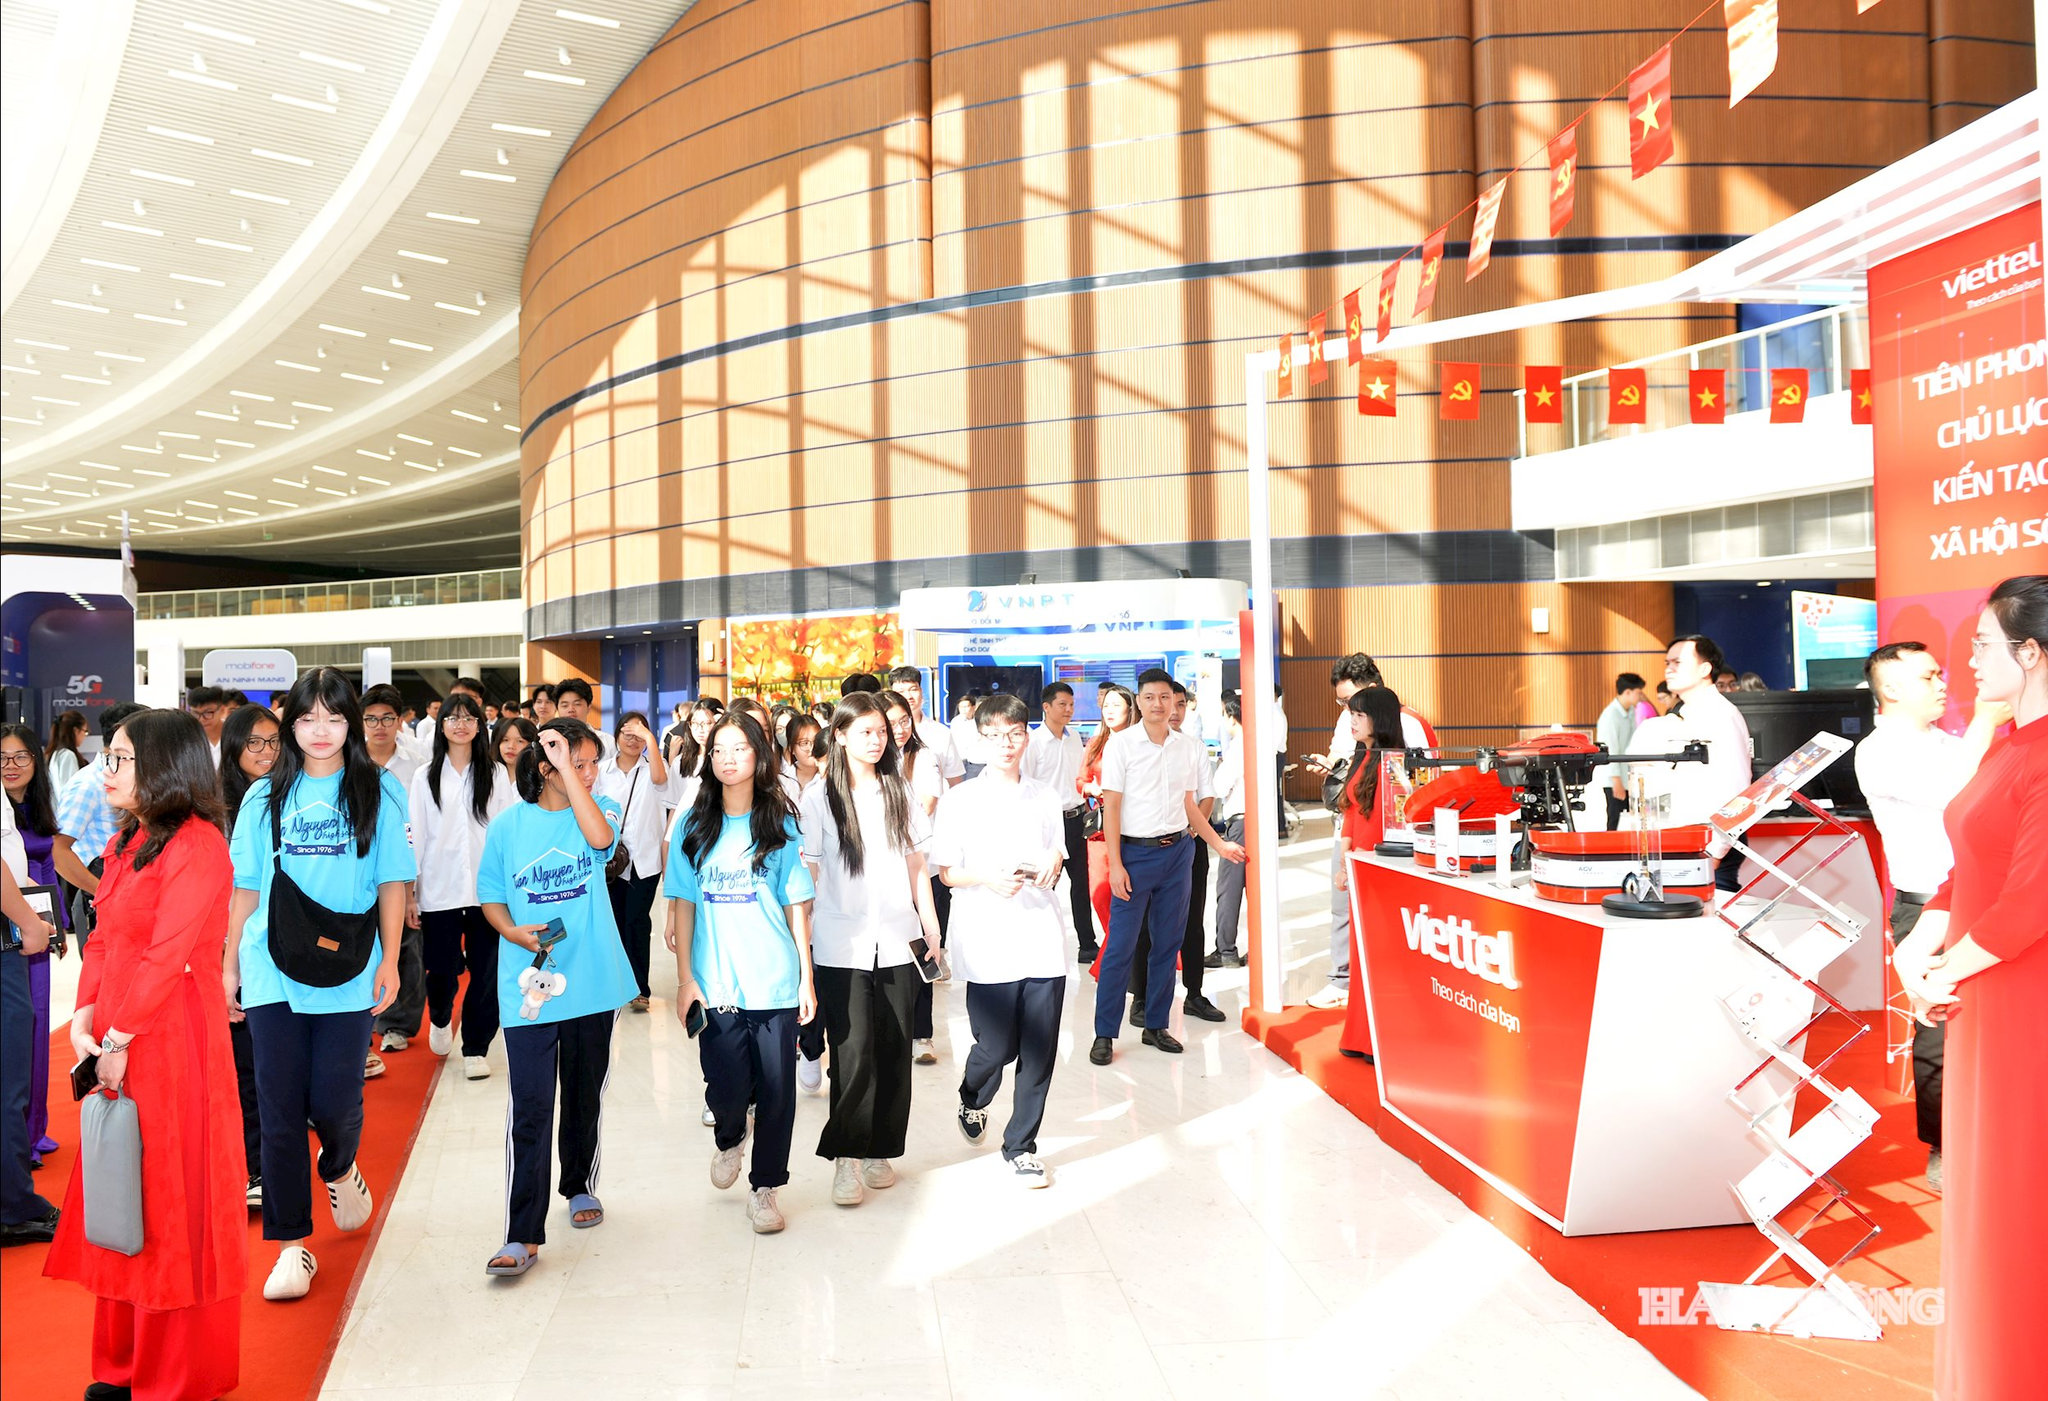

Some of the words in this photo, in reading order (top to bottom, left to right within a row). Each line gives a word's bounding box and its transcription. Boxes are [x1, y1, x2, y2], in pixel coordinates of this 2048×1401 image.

[1942, 242, 2042, 299] viettel
[1912, 361, 1971, 401] TIÊN
[1975, 339, 2048, 385] PHON
[1937, 405, 1992, 448] CHỦ
[1933, 460, 1993, 505] KIẾN
[1930, 525, 1966, 560] XÃ
[1969, 516, 2018, 556] HỘI
[998, 593, 1074, 610] VNPT
[66, 674, 103, 695] 5G
[215, 676, 231, 684] AN
[225, 661, 276, 670] mobifone
[52, 696, 116, 707] mobifone
[532, 864, 574, 891] Nguyen
[1400, 904, 1520, 990] viettel
[1430, 976, 1454, 1002] Theo
[1454, 990, 1478, 1014] cách
[1478, 999, 1498, 1023] của
[1498, 1006, 1521, 1033] bạn
